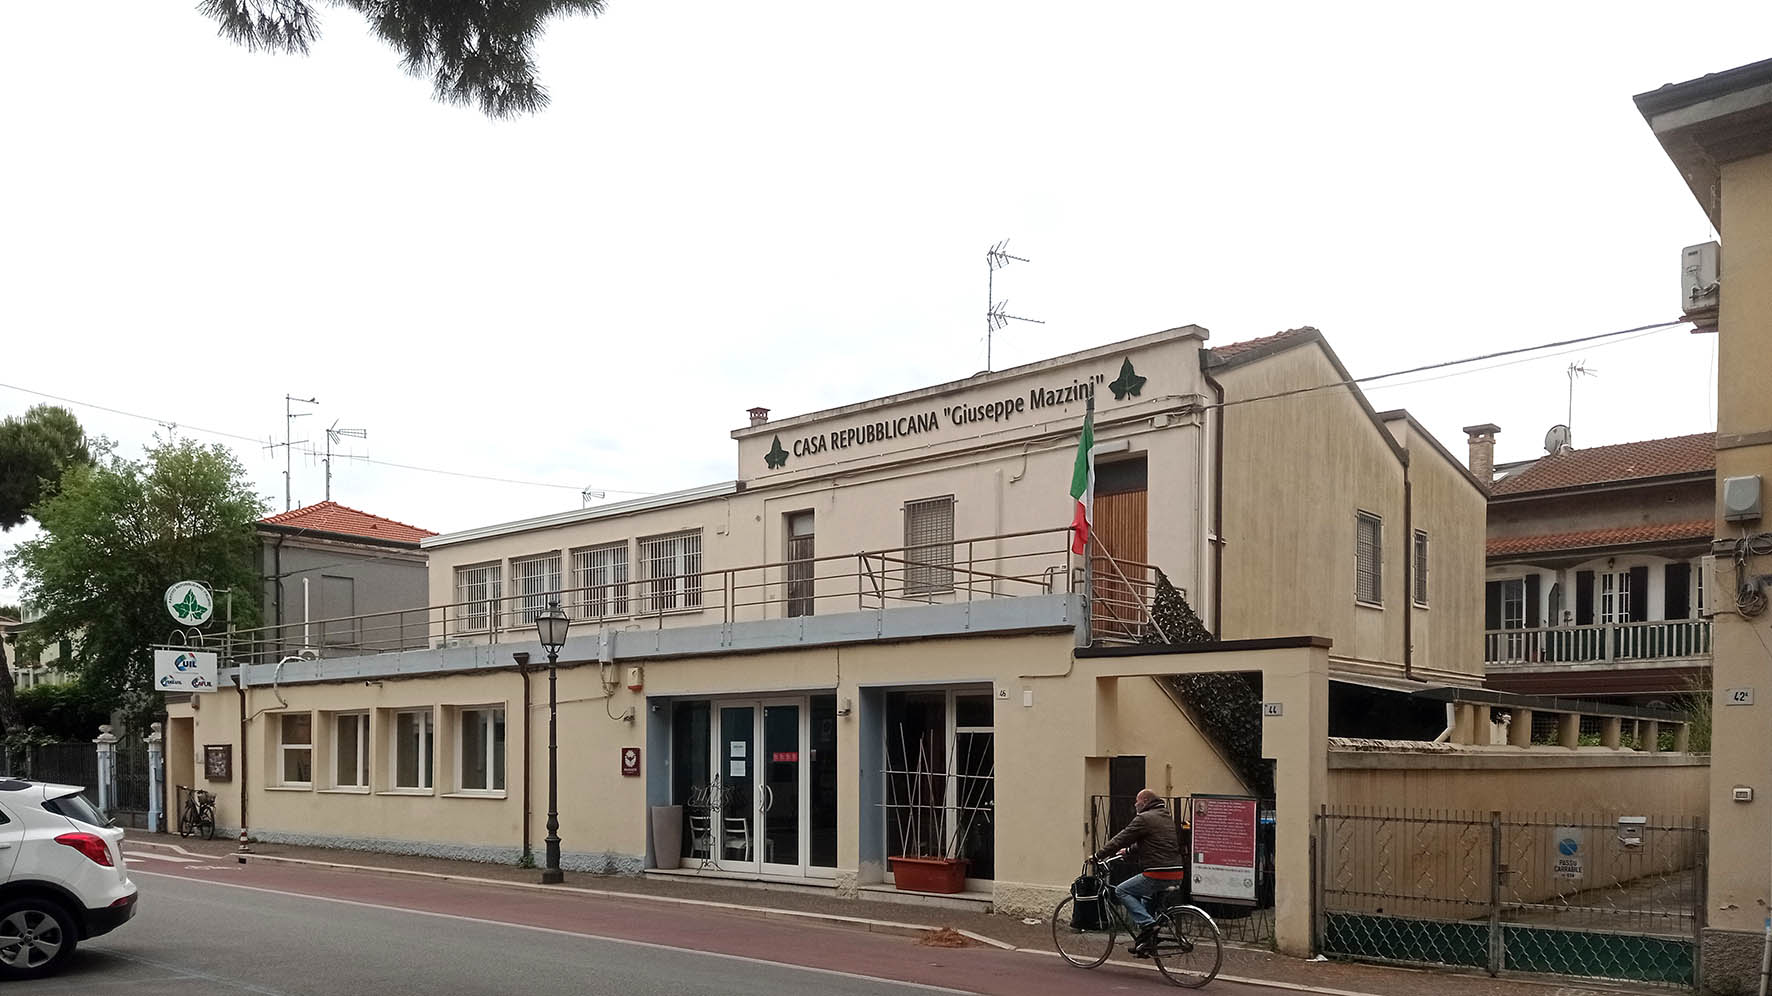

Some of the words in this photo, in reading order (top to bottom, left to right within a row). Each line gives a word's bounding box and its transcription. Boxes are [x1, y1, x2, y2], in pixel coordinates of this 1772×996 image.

[793, 434, 827, 457] CASA
[831, 411, 939, 450] REPUBBLICANA
[943, 396, 1025, 426] "Giuseppe
[1030, 373, 1104, 410] Mazzini"
[182, 660, 197, 668] UIL
[1559, 859, 1577, 867] PASSO
